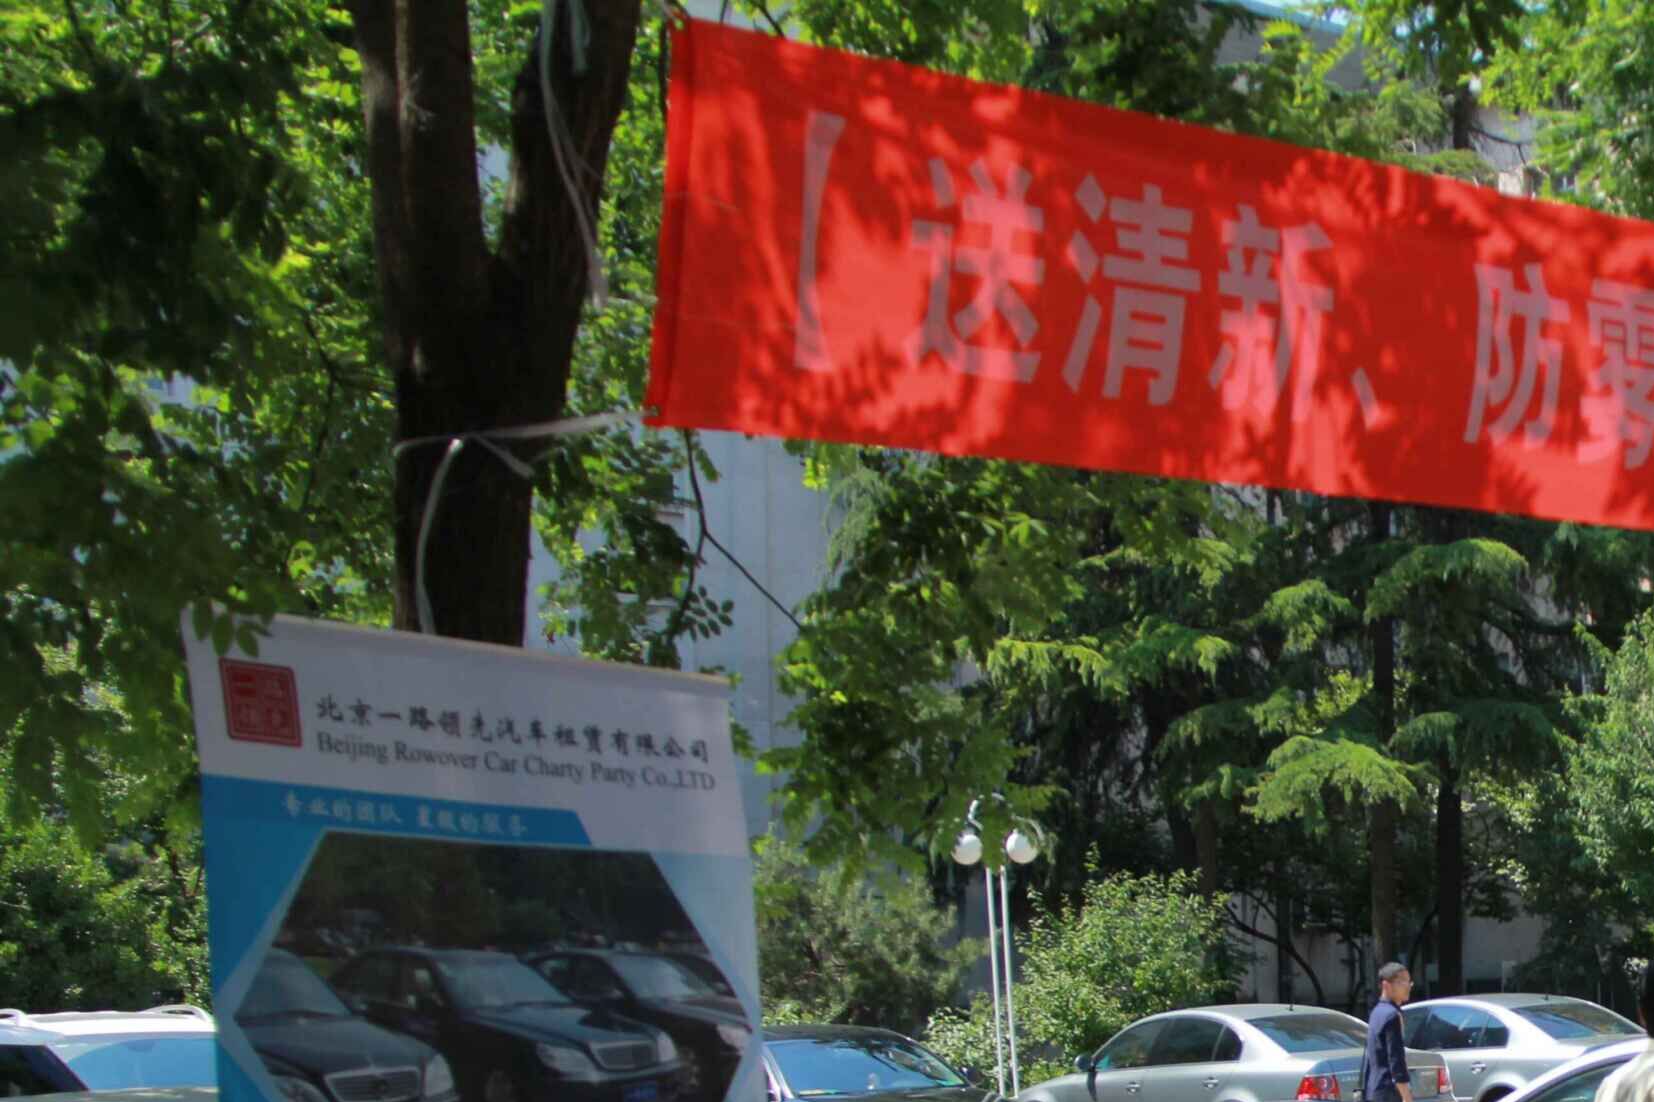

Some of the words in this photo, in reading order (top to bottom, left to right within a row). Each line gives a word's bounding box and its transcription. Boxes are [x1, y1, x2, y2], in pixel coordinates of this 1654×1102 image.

[319, 732, 388, 764] Beijing
[395, 740, 480, 770] Rowover
[484, 750, 517, 774] Car
